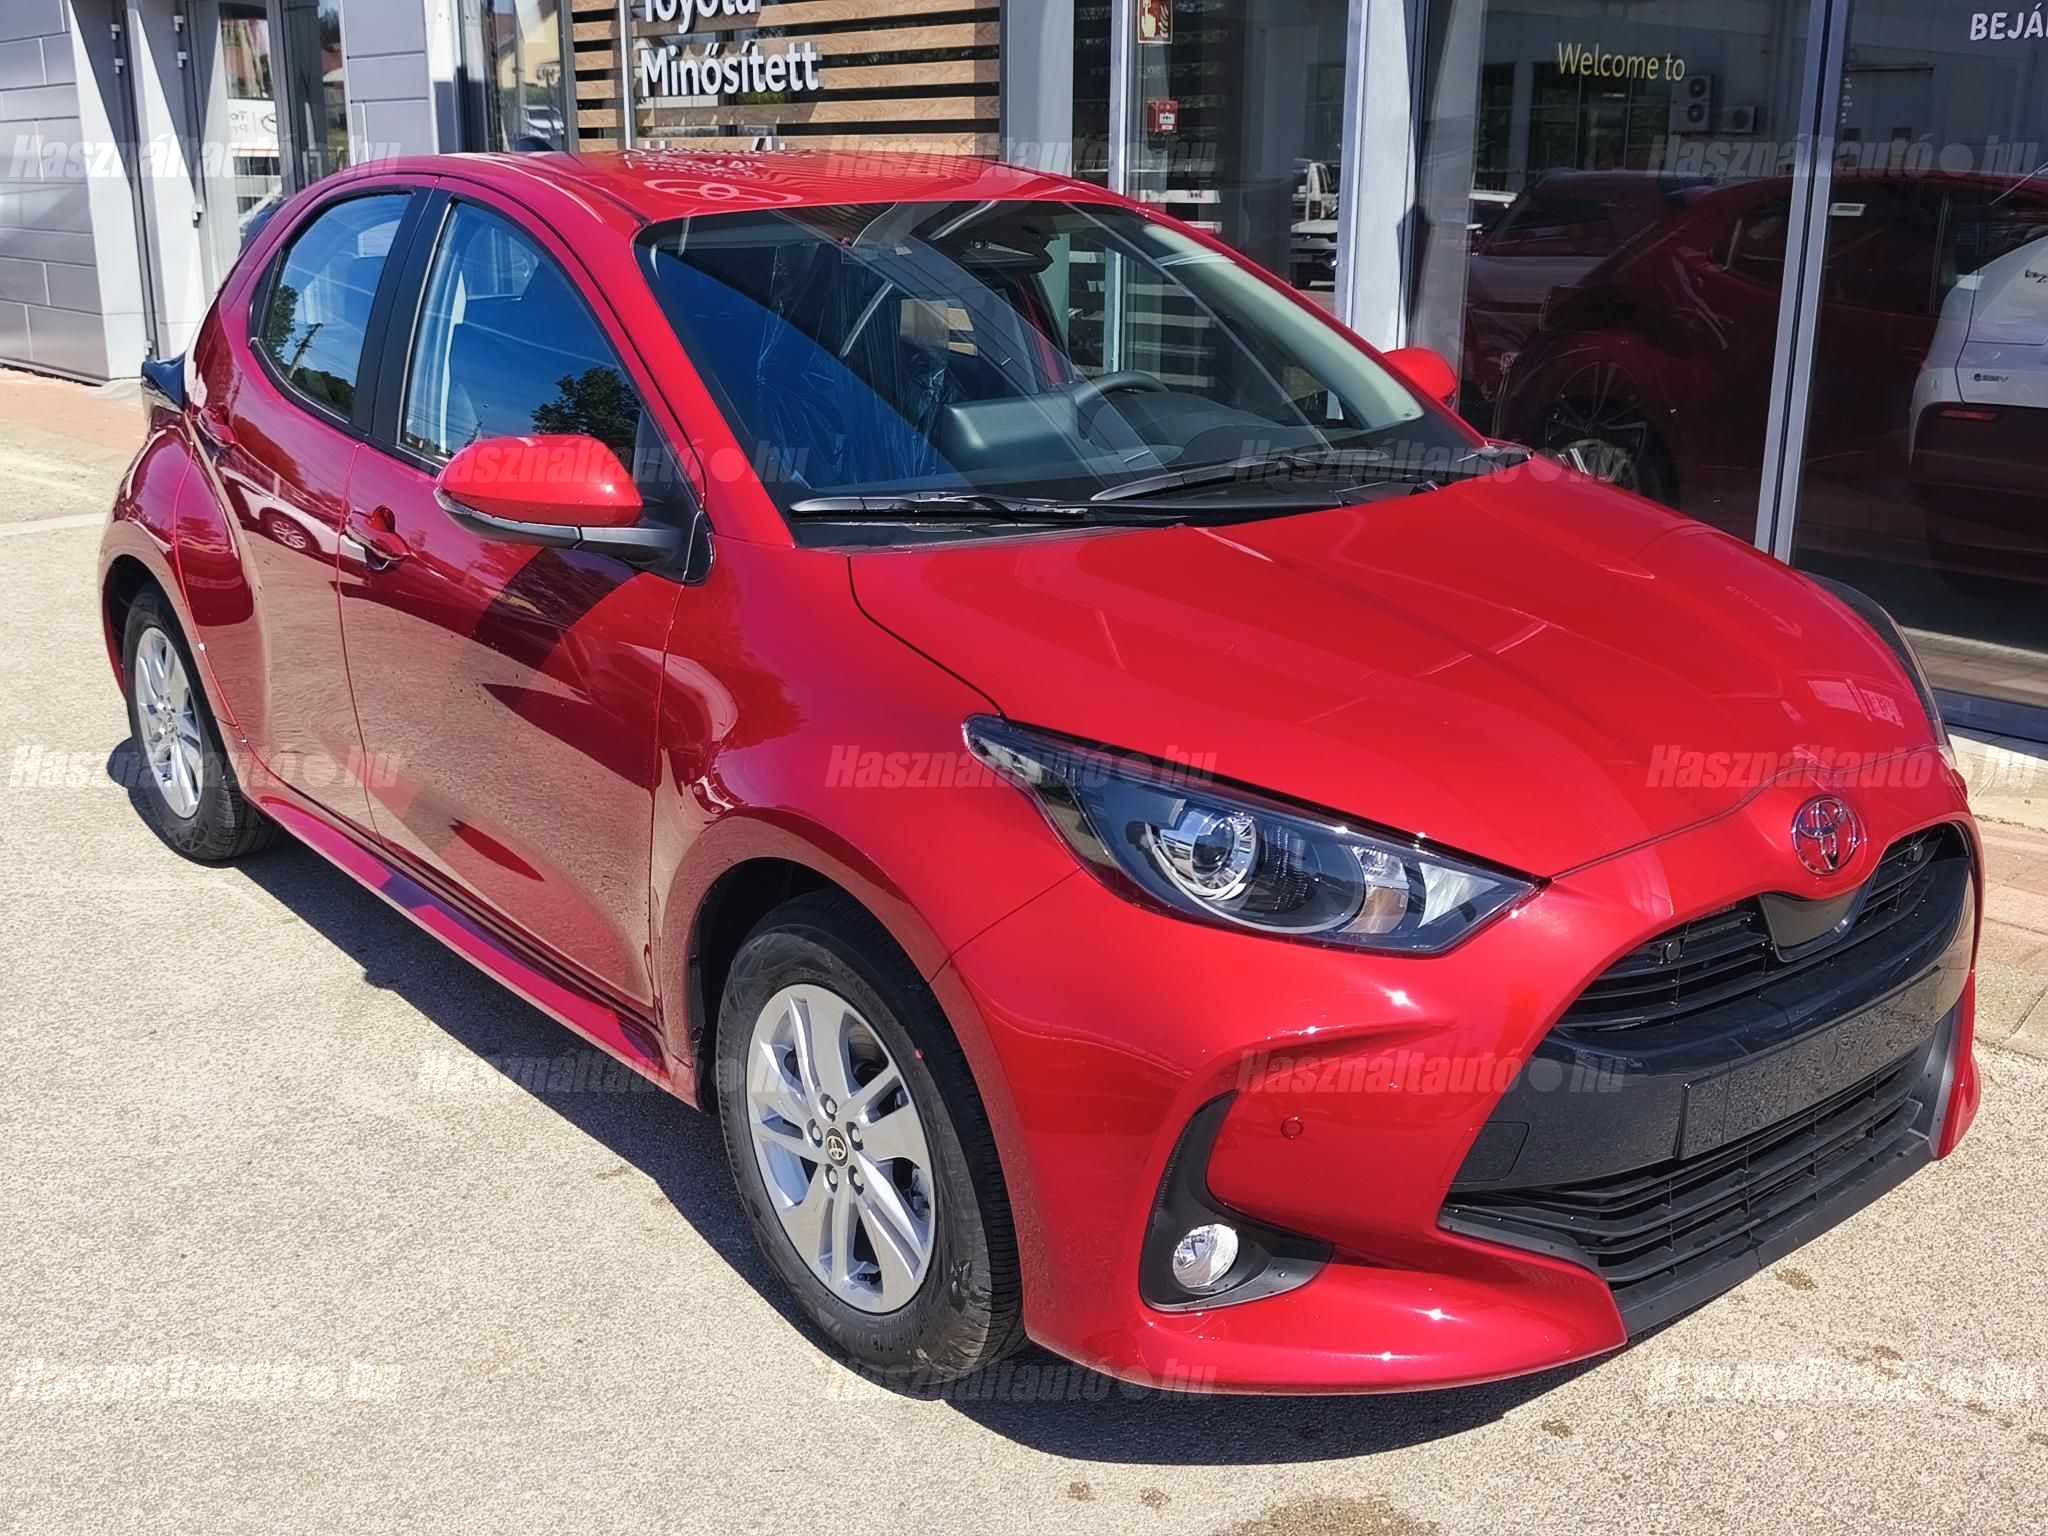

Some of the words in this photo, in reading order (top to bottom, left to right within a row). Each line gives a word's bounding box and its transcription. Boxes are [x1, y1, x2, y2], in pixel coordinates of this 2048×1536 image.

[1969, 2, 2048, 41] BEJÁ
[640, 40, 819, 97] Minősített
[1558, 41, 1659, 80] Welcome
[1665, 52, 1686, 81] to
